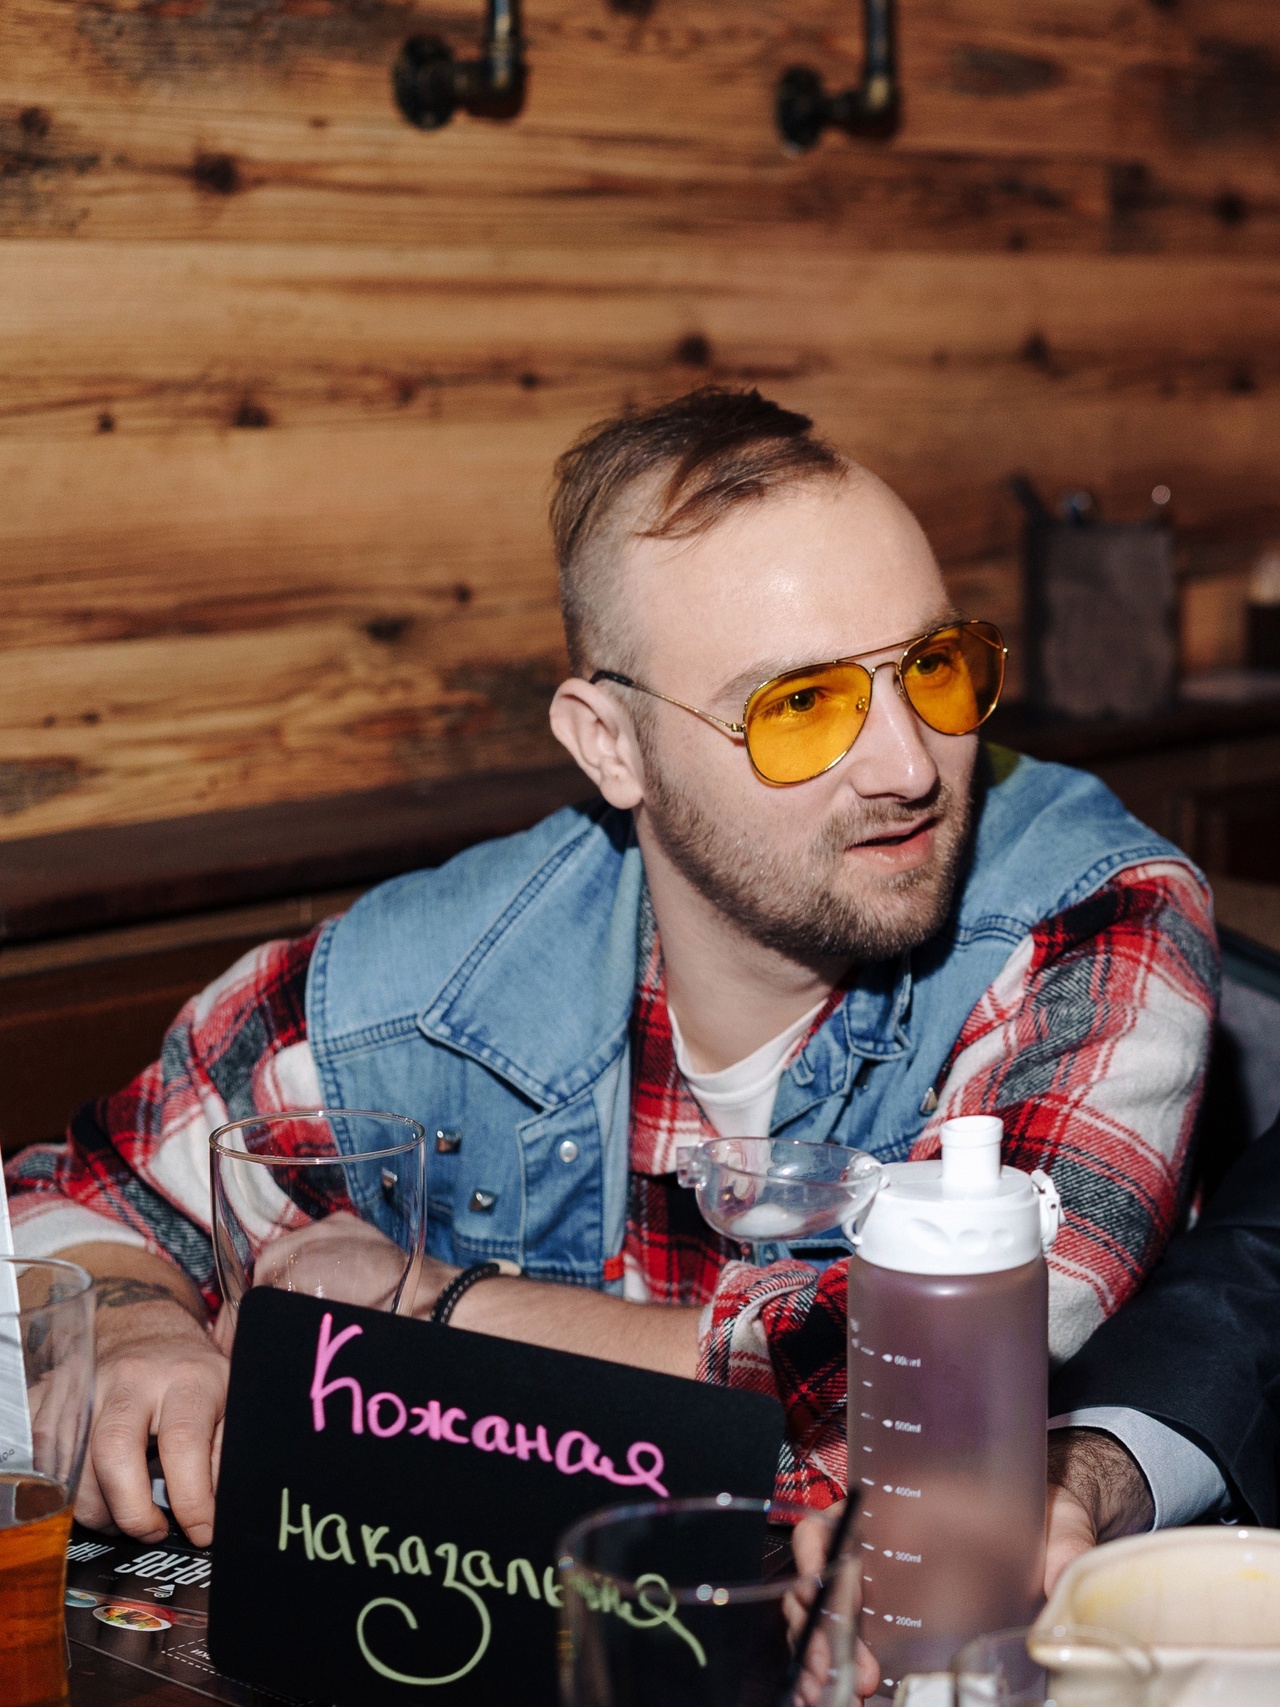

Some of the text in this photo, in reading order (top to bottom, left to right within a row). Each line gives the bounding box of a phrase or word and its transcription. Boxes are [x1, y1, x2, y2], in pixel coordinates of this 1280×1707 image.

[894, 1354, 921, 1368] 60ml
[310, 1313, 669, 1498] Кожаная
[894, 1420, 921, 1433] 500ml
[895, 1486, 921, 1498] 400ml
[895, 1551, 922, 1564] 300ml
[113, 1551, 213, 1588] BERG
[895, 1615, 922, 1629] 200ml
